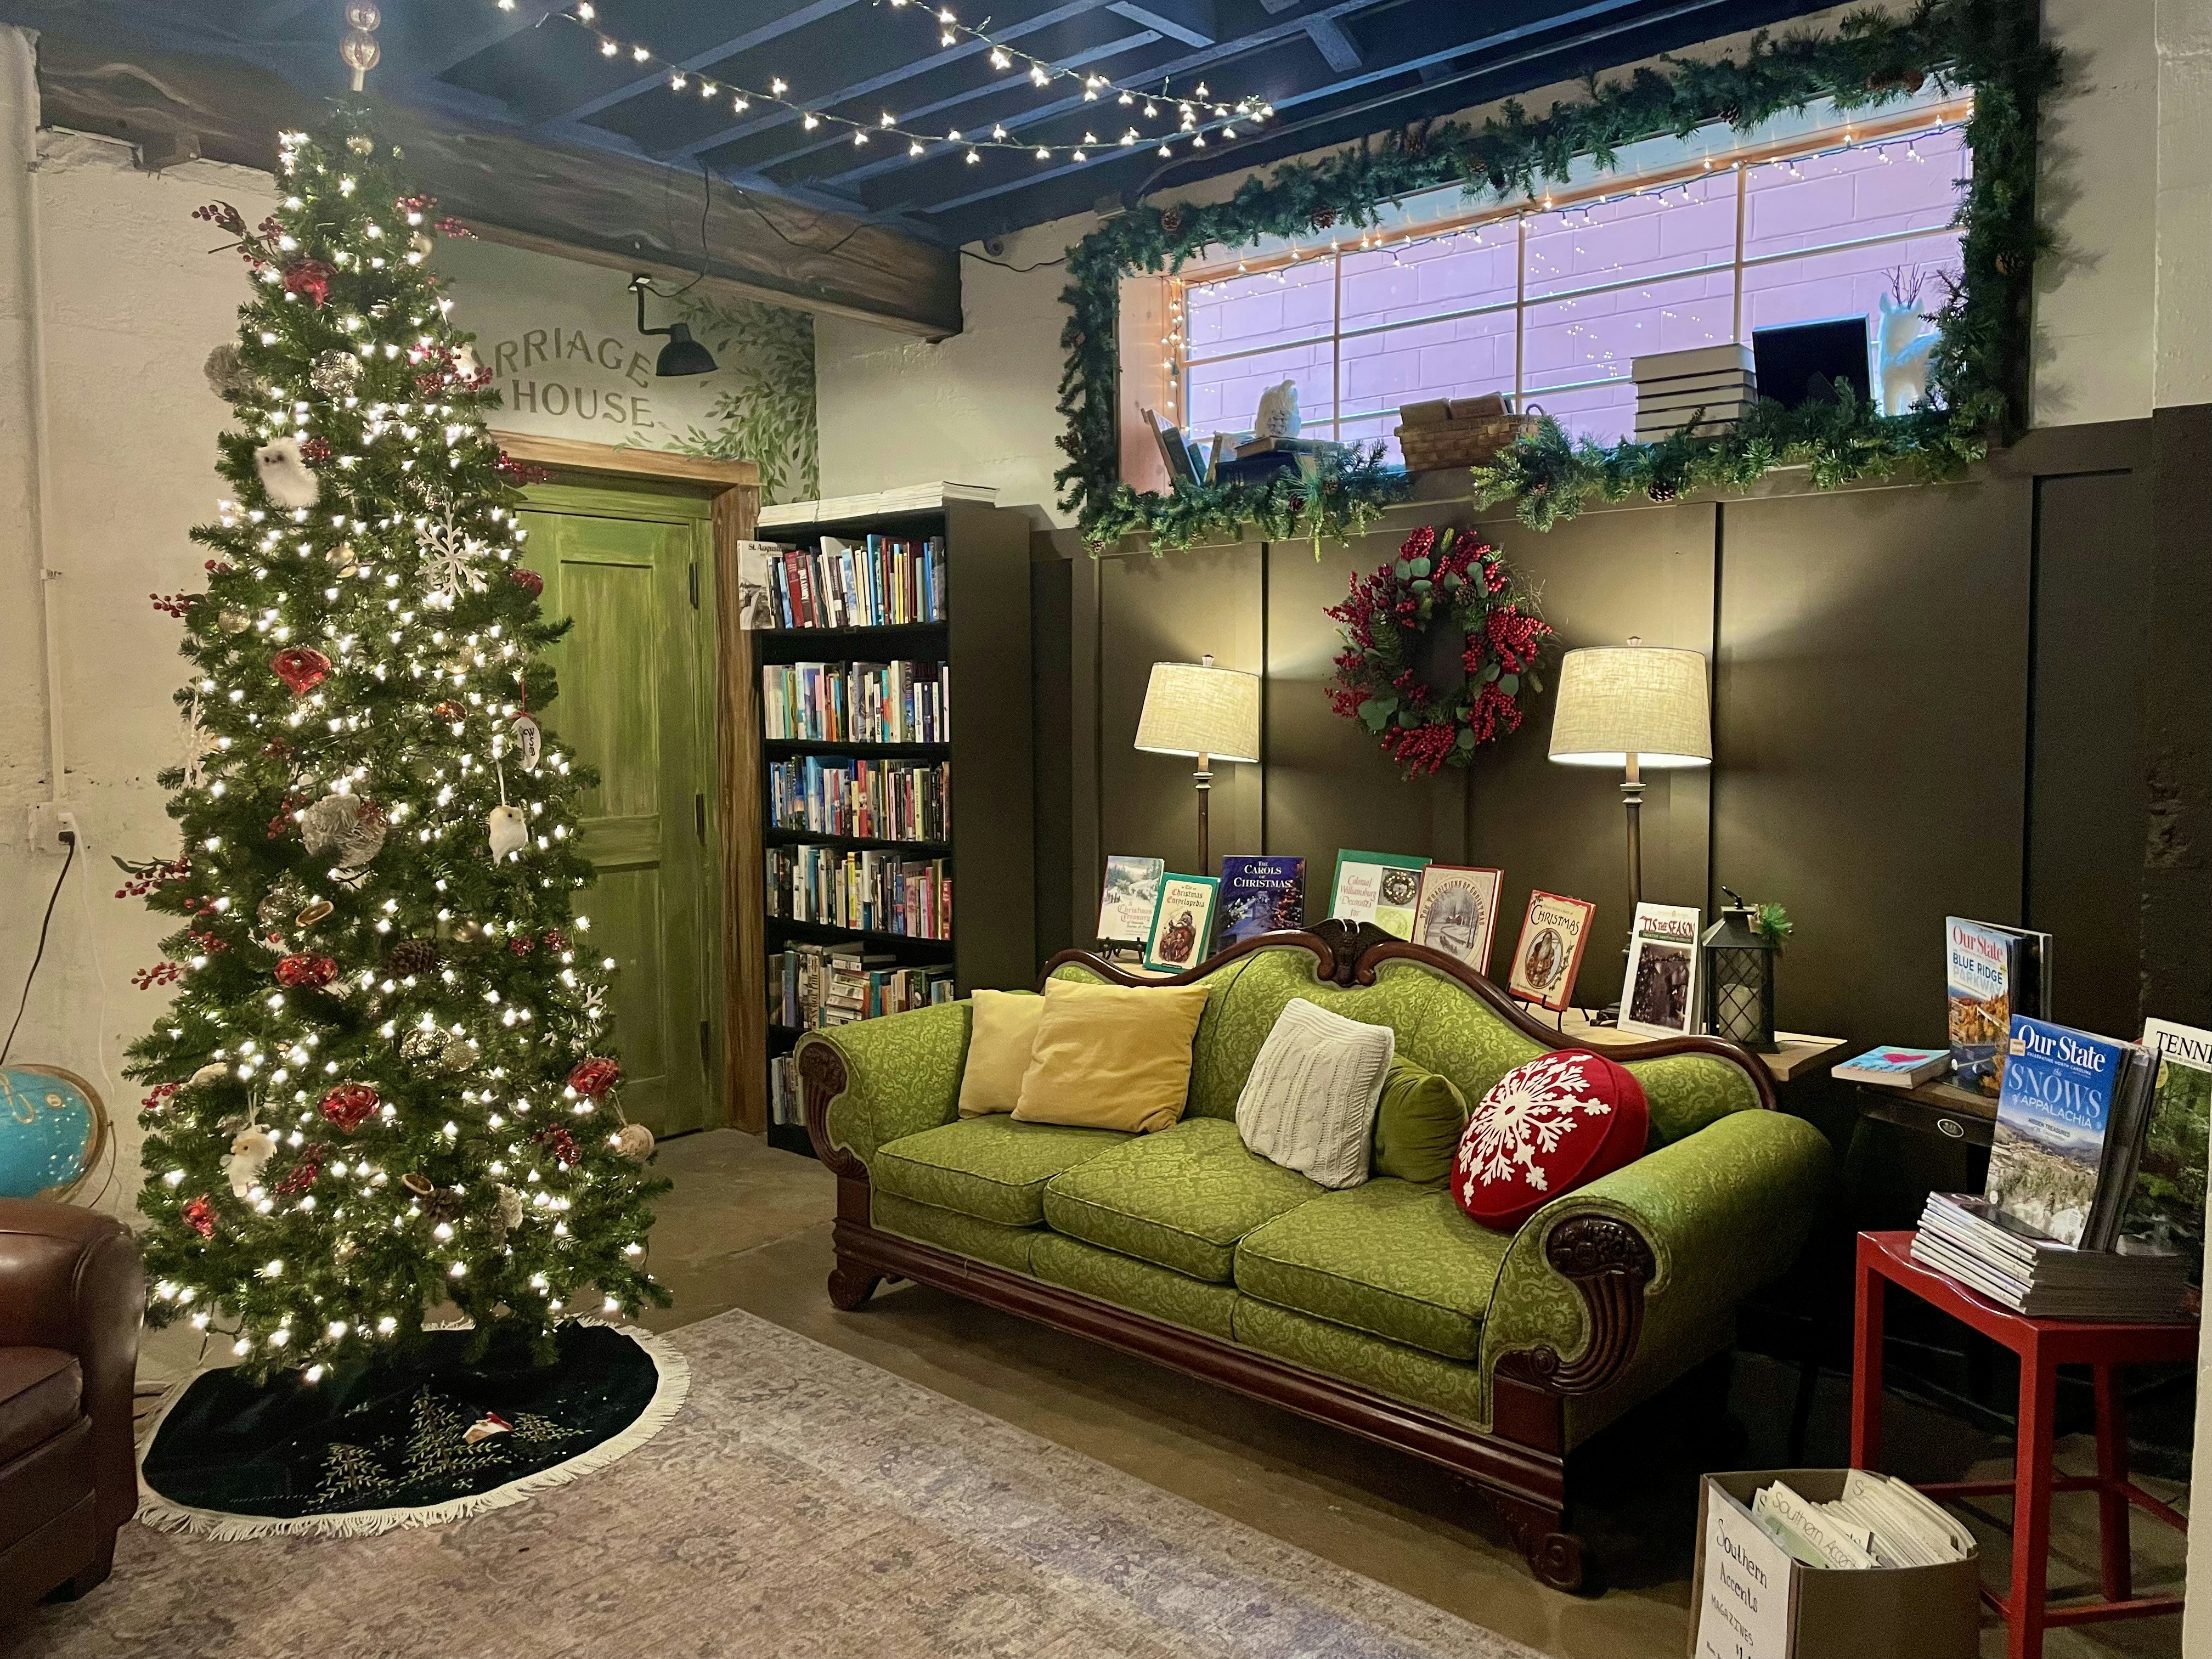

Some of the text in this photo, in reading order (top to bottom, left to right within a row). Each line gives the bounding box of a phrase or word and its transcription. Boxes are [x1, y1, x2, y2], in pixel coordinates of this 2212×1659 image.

[472, 327, 650, 388] RRIAGE
[512, 380, 654, 428] HOUSE
[1233, 877, 1294, 888] CHRISTMAS
[1244, 865, 1282, 874] CAROLS
[1347, 875, 1373, 888] Colonial
[1118, 904, 1152, 915] Christmas
[1166, 896, 1205, 907] Encyclopedia
[1172, 888, 1203, 899] Christmas
[1340, 884, 1377, 902] Williamsburg
[1426, 881, 1462, 903] TRADITIONS
[1470, 886, 1485, 926] CHRISTMAS
[1531, 905, 1580, 936] CHRISTMAS
[1668, 920, 1696, 938] SEASON
[1953, 925, 1976, 950] Our
[1977, 934, 2003, 963] State
[1953, 952, 1974, 972] BLUE
[1977, 962, 2002, 985] RIDGE
[1953, 966, 2002, 995] PARKWAY
[2018, 1024, 2106, 1073] Our State
[2156, 1031, 2211, 1064] TENN
[2008, 1063, 2102, 1119] SNOWS
[2021, 1095, 2092, 1130] APPALACHIA
[1772, 1492, 1824, 1545] Southern
[1717, 1519, 1767, 1589] Southern
[1720, 1561, 1758, 1613] Accents
[1711, 1593, 1753, 1646] MAGAZINES
